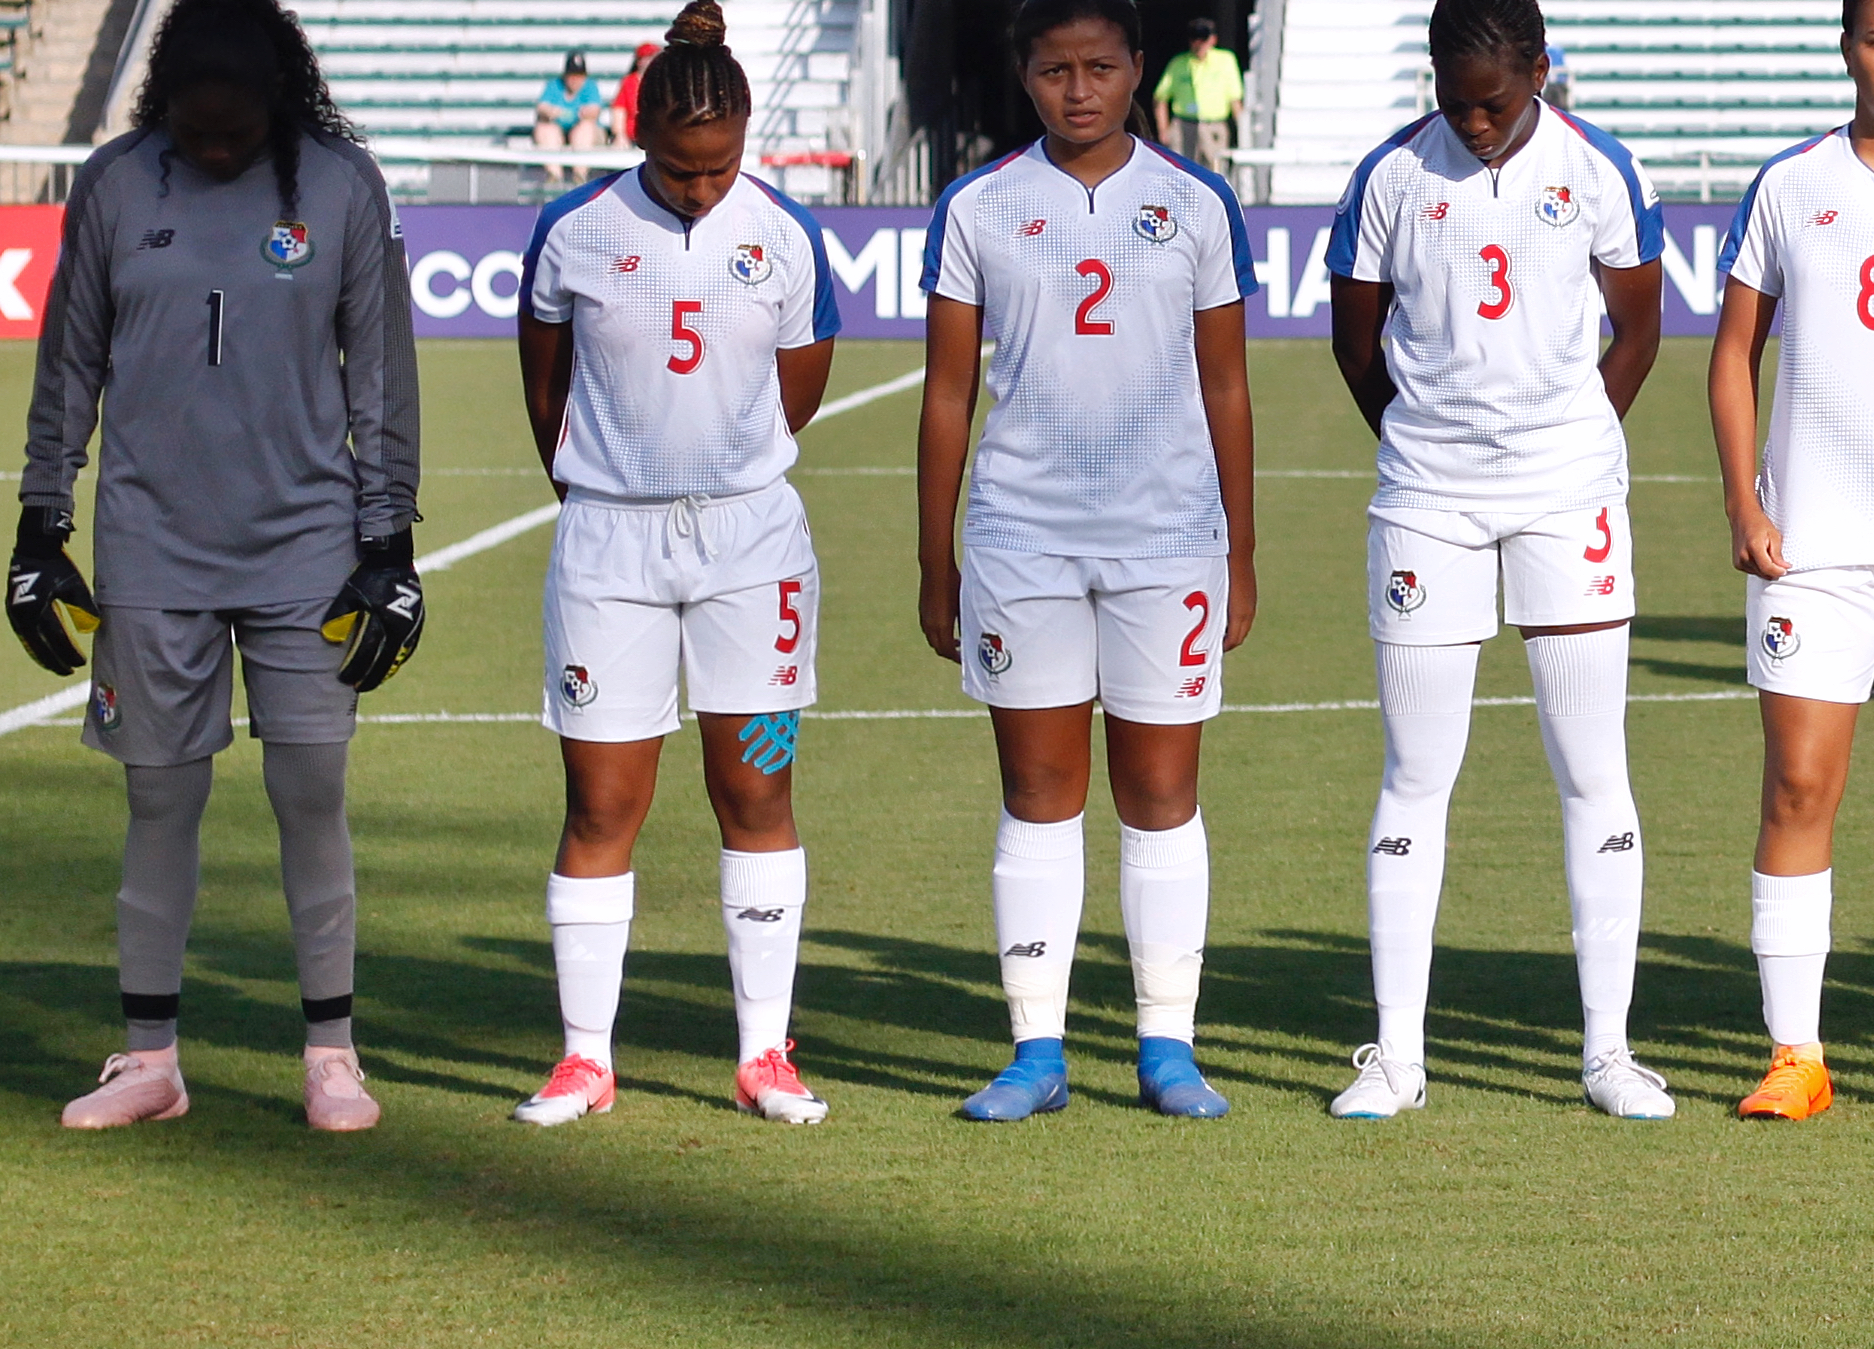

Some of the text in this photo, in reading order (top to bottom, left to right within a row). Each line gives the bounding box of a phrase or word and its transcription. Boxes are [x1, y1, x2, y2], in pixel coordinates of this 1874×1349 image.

[1075, 258, 1115, 336] 2
[1477, 243, 1514, 320] 3
[206, 288, 224, 366] 1
[667, 300, 704, 375] 5
[775, 581, 802, 654] 5
[1180, 590, 1210, 667] 2
